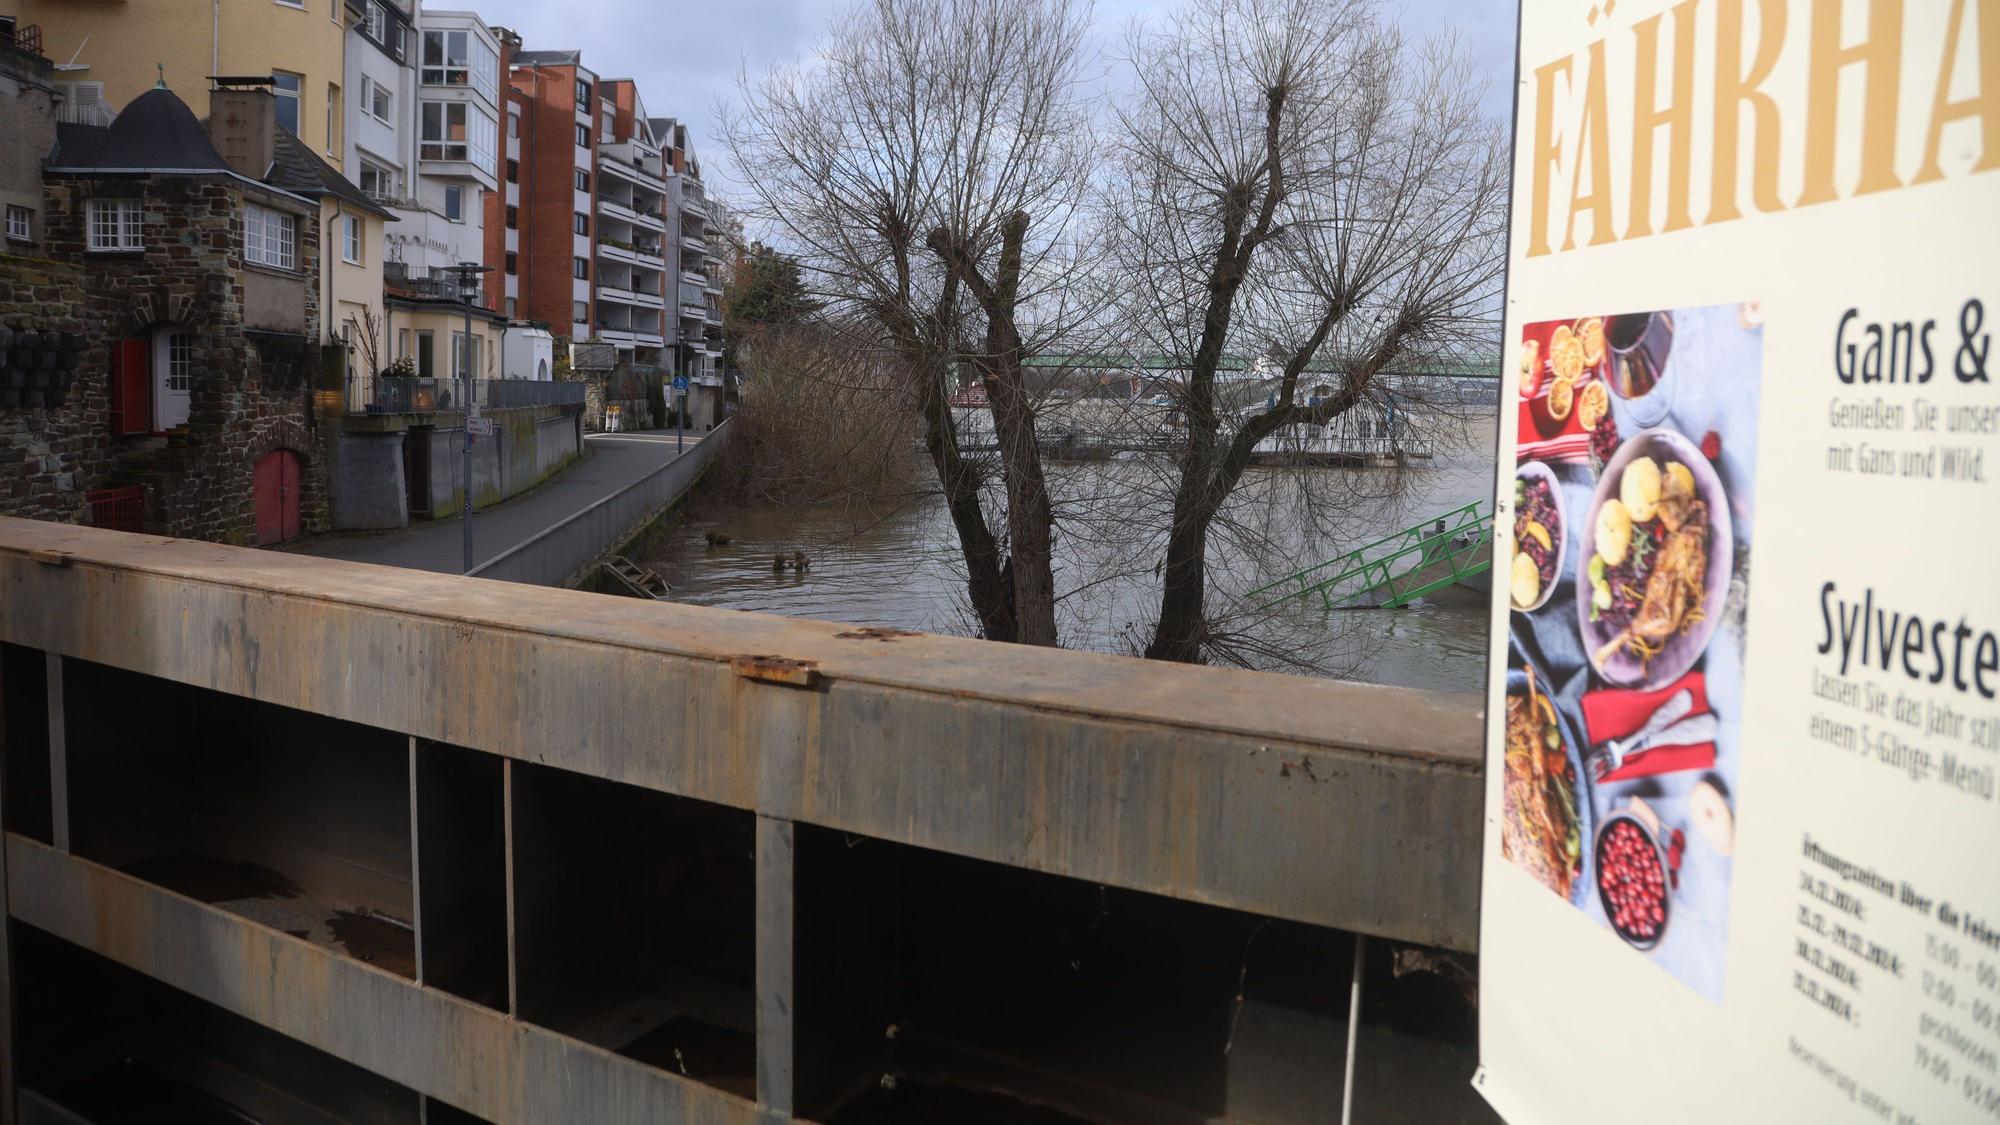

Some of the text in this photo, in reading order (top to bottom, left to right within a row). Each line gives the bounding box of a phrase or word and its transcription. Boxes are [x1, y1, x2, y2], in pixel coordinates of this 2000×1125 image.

[1526, 0, 2000, 258] FÄHRHA
[1835, 297, 1990, 384] Gans &
[1830, 396, 1904, 430] Genießen
[1912, 397, 1938, 432] Sie
[1826, 443, 1853, 472] mit
[1857, 442, 1896, 475] Gans
[1900, 444, 1936, 479] und
[1818, 580, 2000, 699] Sylveste
[1809, 711, 1858, 751] einem
[1812, 666, 1861, 708] Lassen
[1864, 680, 1889, 718] Sie
[1893, 689, 1922, 728] das
[1925, 698, 1965, 739] Jahr
